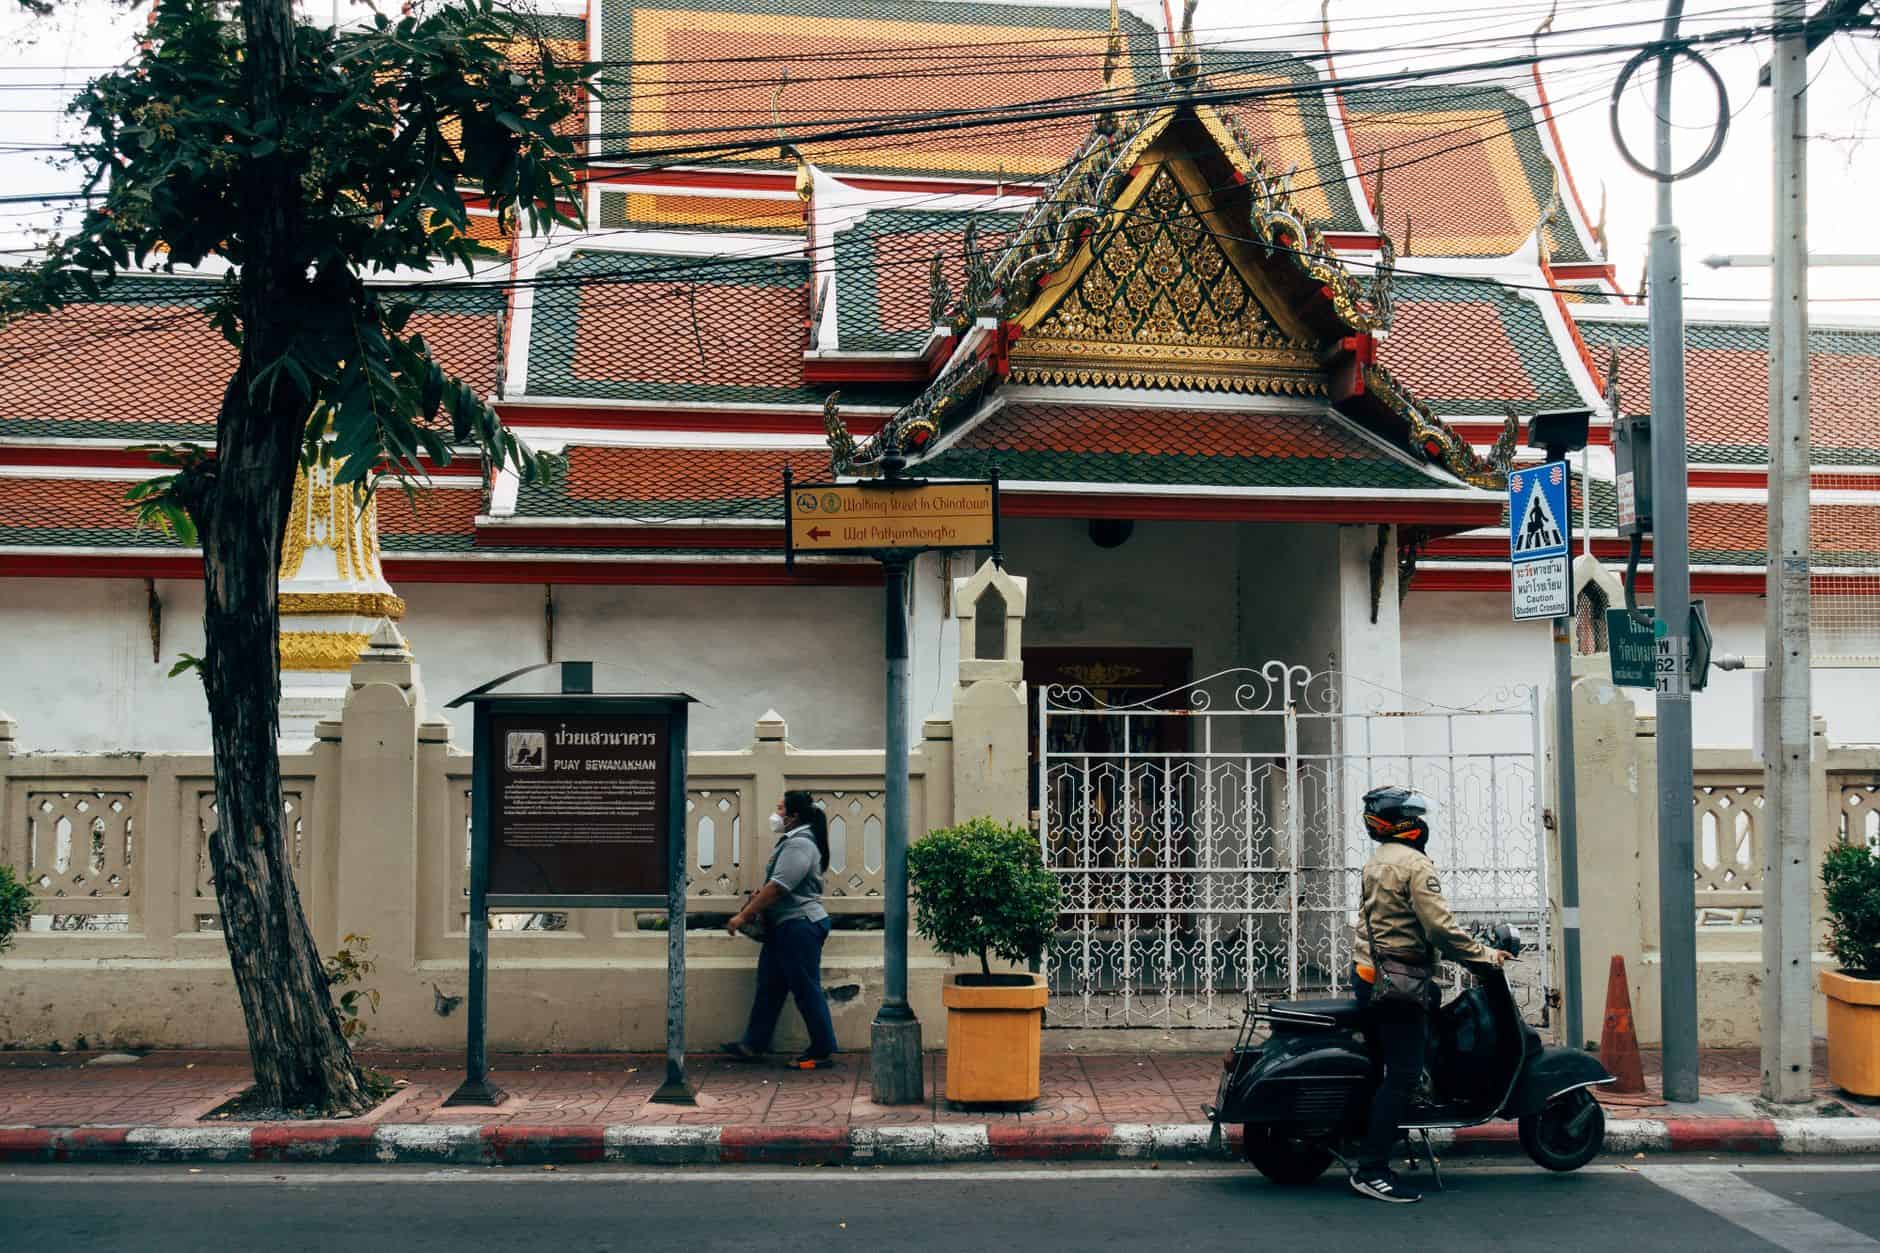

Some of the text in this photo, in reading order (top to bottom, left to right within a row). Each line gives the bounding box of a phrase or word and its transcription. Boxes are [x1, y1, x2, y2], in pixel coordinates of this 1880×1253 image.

[932, 496, 990, 511] Chinatown
[843, 527, 867, 541] Wat
[1526, 595, 1554, 604] Caution
[553, 759, 657, 771] PUAY SEWANAKHAN
